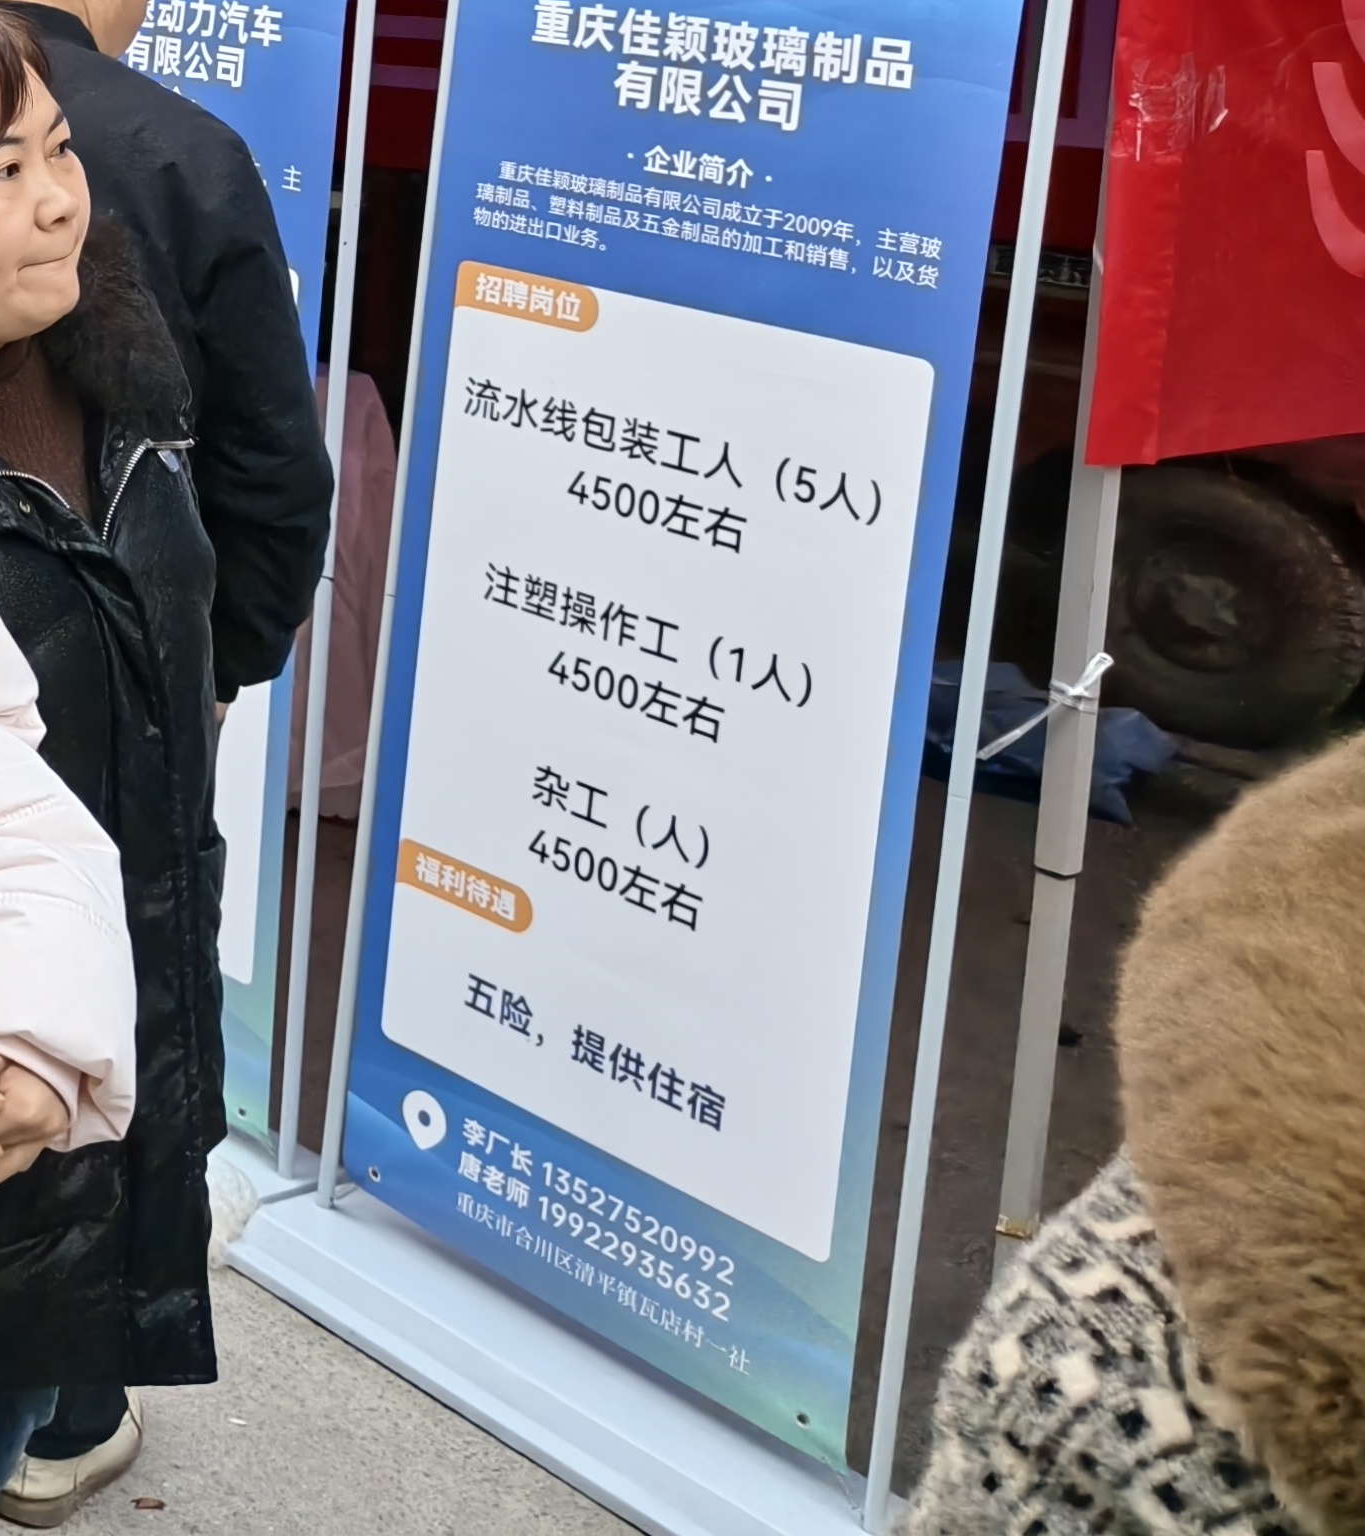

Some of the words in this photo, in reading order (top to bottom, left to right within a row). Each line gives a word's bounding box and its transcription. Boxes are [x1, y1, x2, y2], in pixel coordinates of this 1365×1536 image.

[125, 31, 245, 88] 有限公司
[612, 60, 803, 132] 有限公司
[472, 207, 609, 253] 物的进出口业务。
[475, 182, 940, 290] 璃制品、塑料制品及五金制品的加工和销售，以及货
[497, 160, 943, 262] 重庆佳颖玻璃制品有限公司成立于2009年，主营玻
[474, 272, 582, 323] 招聘岗位
[462, 375, 885, 528] 流水线包装工人（5人）
[566, 468, 749, 554] 4500左右
[482, 562, 815, 709] 注塑操作工（1人）
[547, 649, 727, 745] 4500左右
[530, 766, 713, 871] 杂工（人）
[414, 852, 517, 923] 福利待遇
[526, 828, 705, 933] 4500左右
[462, 972, 728, 1134] 五险，提供住宿
[456, 1151, 530, 1211] 唐老师
[536, 1195, 733, 1324] 19922935632
[461, 1116, 535, 1178] 李厂长
[541, 1159, 737, 1287] 13527520992
[454, 1190, 753, 1377] 重庆市合川区清平镇瓦店村一社
